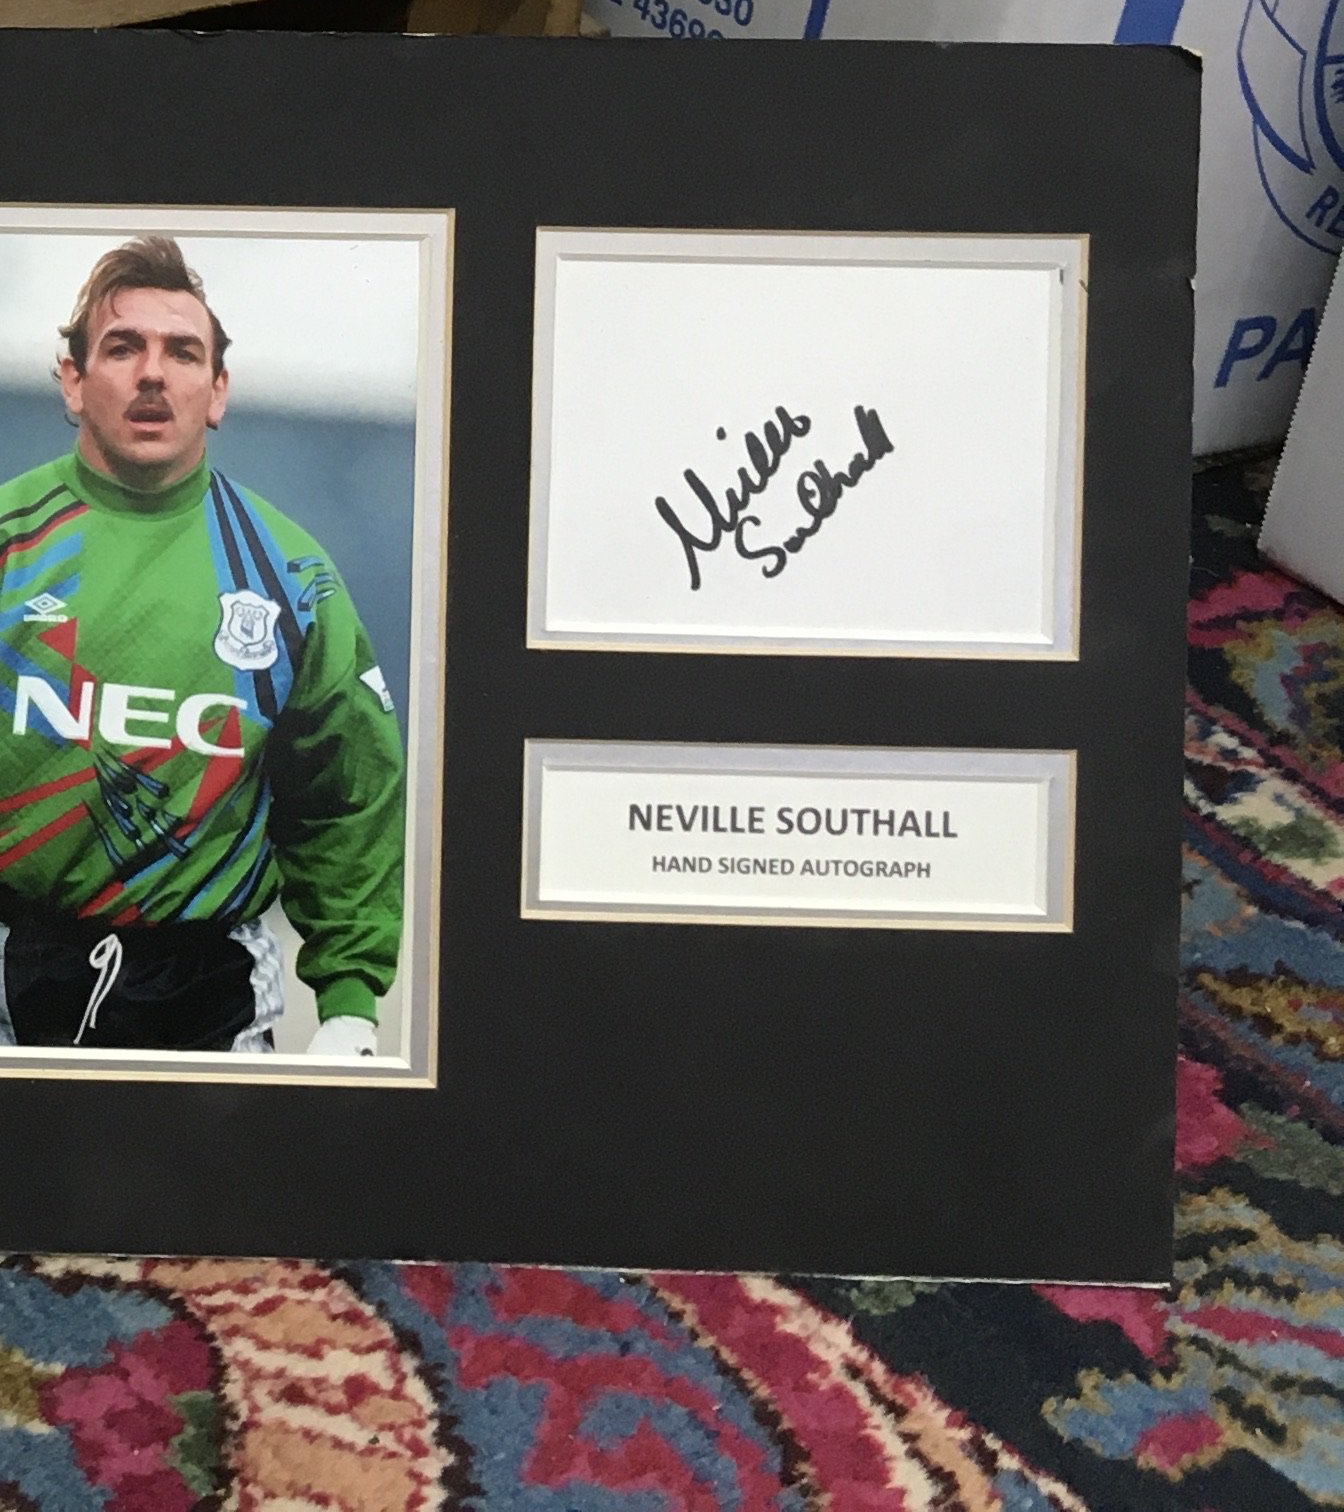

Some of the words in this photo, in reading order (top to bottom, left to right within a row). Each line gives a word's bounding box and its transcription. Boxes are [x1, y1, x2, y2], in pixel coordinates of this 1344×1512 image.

[12, 675, 247, 758] NEC
[628, 803, 765, 834] NEVILLE
[775, 807, 958, 839] SOUTHALL
[652, 855, 713, 875] HAND
[717, 856, 795, 877] SIGNED
[800, 858, 932, 879] AUTOGRAPH
